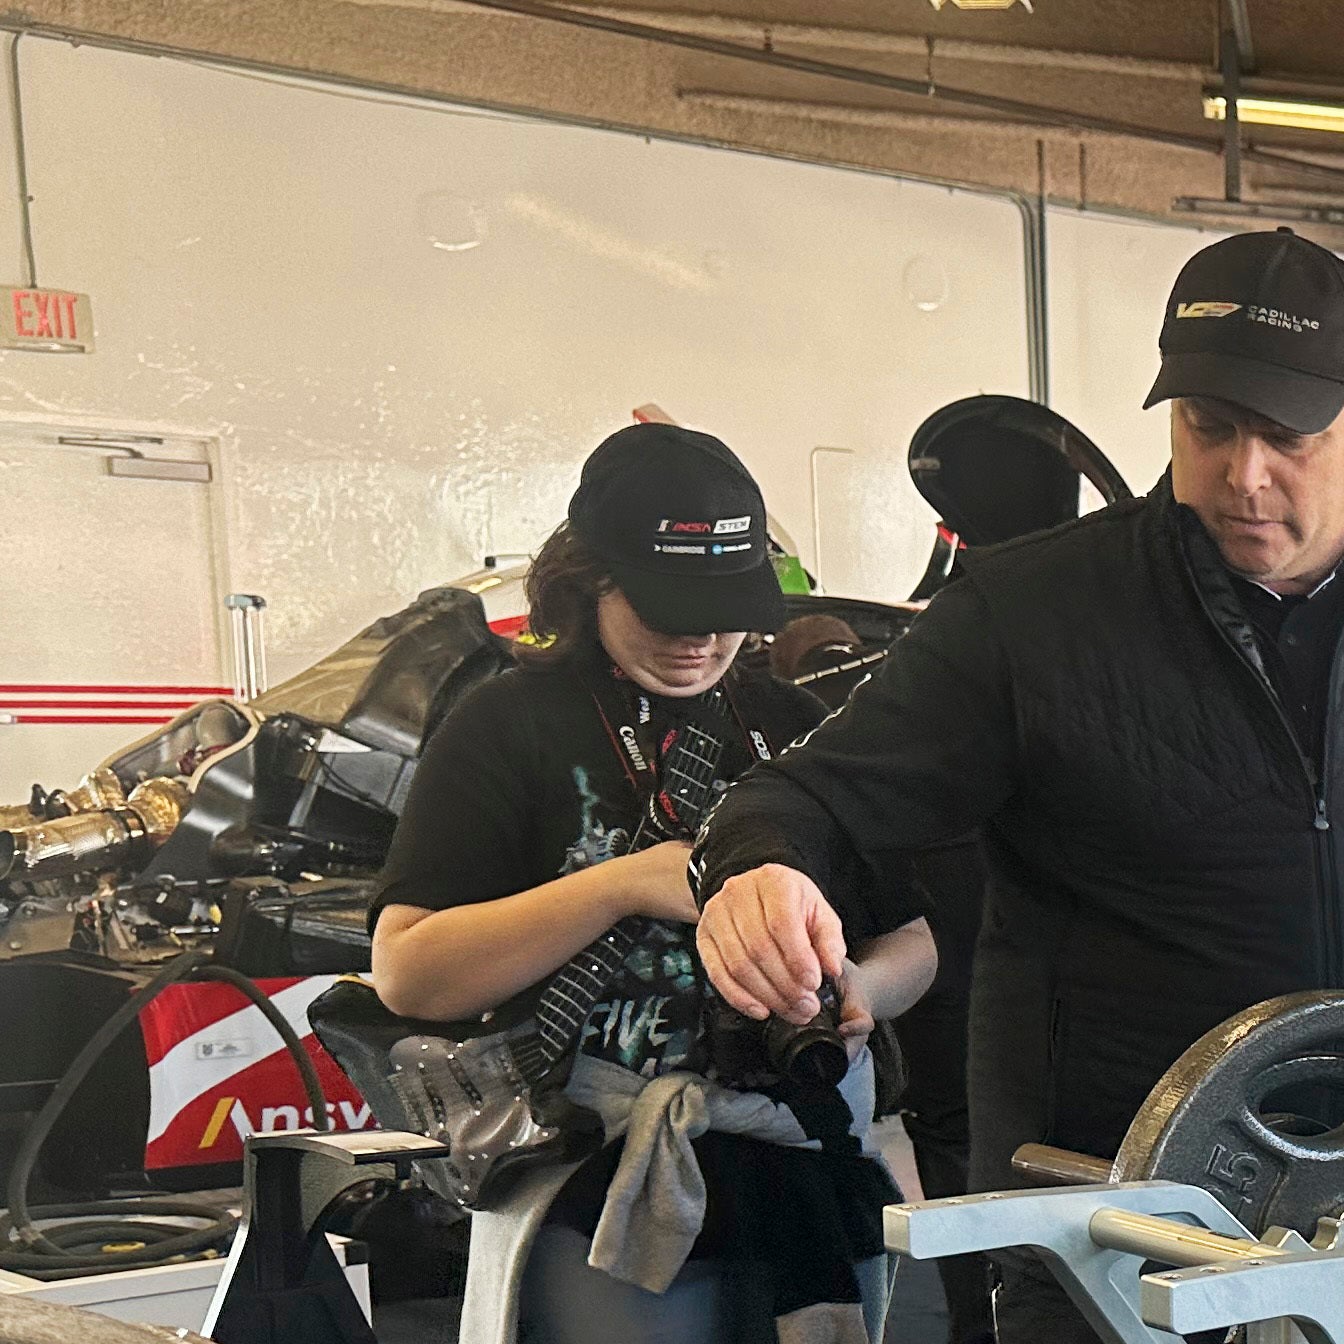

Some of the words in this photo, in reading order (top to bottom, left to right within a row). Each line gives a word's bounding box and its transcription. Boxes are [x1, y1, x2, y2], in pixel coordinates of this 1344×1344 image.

[12, 291, 77, 339] EXIT
[1247, 313, 1303, 333] RACING
[1248, 305, 1320, 330] CADILLAC
[619, 725, 648, 771] Canon
[579, 995, 673, 1049] FIVE
[199, 1097, 382, 1148] Ansy
